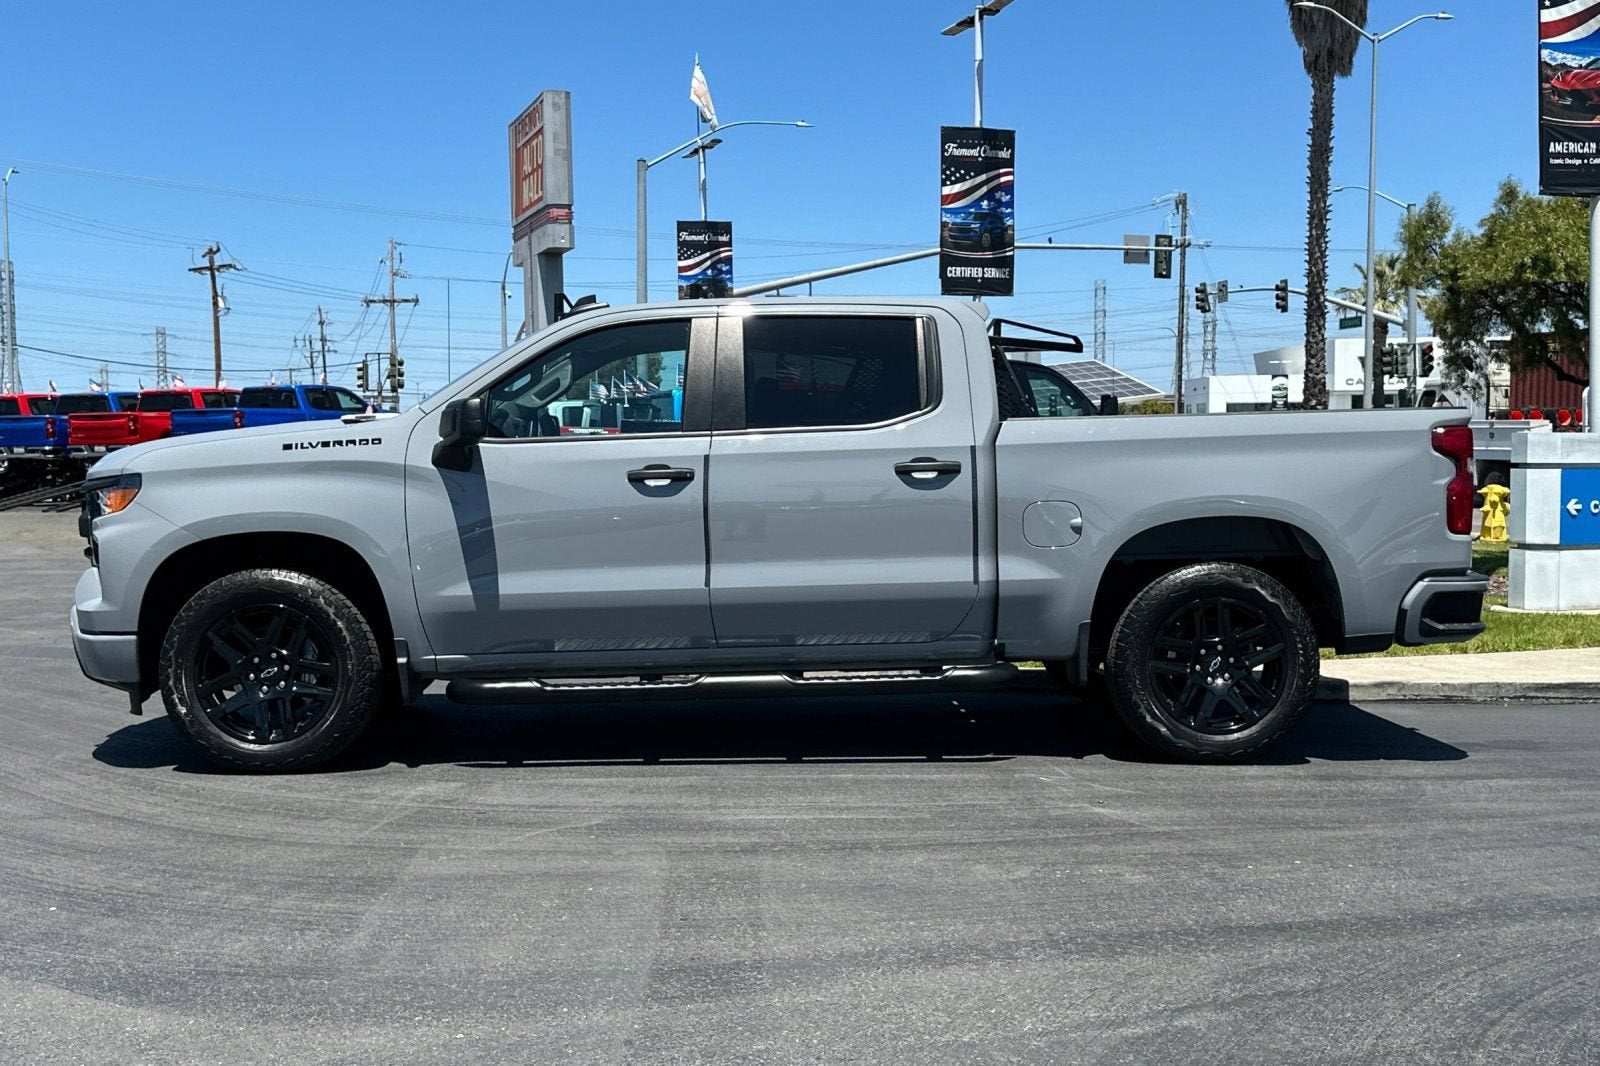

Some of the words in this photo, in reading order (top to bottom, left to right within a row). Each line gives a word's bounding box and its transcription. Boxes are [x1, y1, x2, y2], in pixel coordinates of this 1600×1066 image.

[944, 143, 980, 157] Fremont
[980, 144, 1012, 159] Chevrolet
[1549, 141, 1597, 154] AMERICAN
[522, 134, 543, 178] AUTO
[1564, 157, 1582, 166] Design
[522, 167, 543, 209] MALL
[679, 231, 705, 242] Fremont
[946, 266, 983, 278] CERTIFIED
[983, 267, 1010, 279] SERVICE
[1345, 378, 1414, 386] CALA
[282, 437, 382, 451] SILVERADO
[1590, 500, 1600, 514] C
